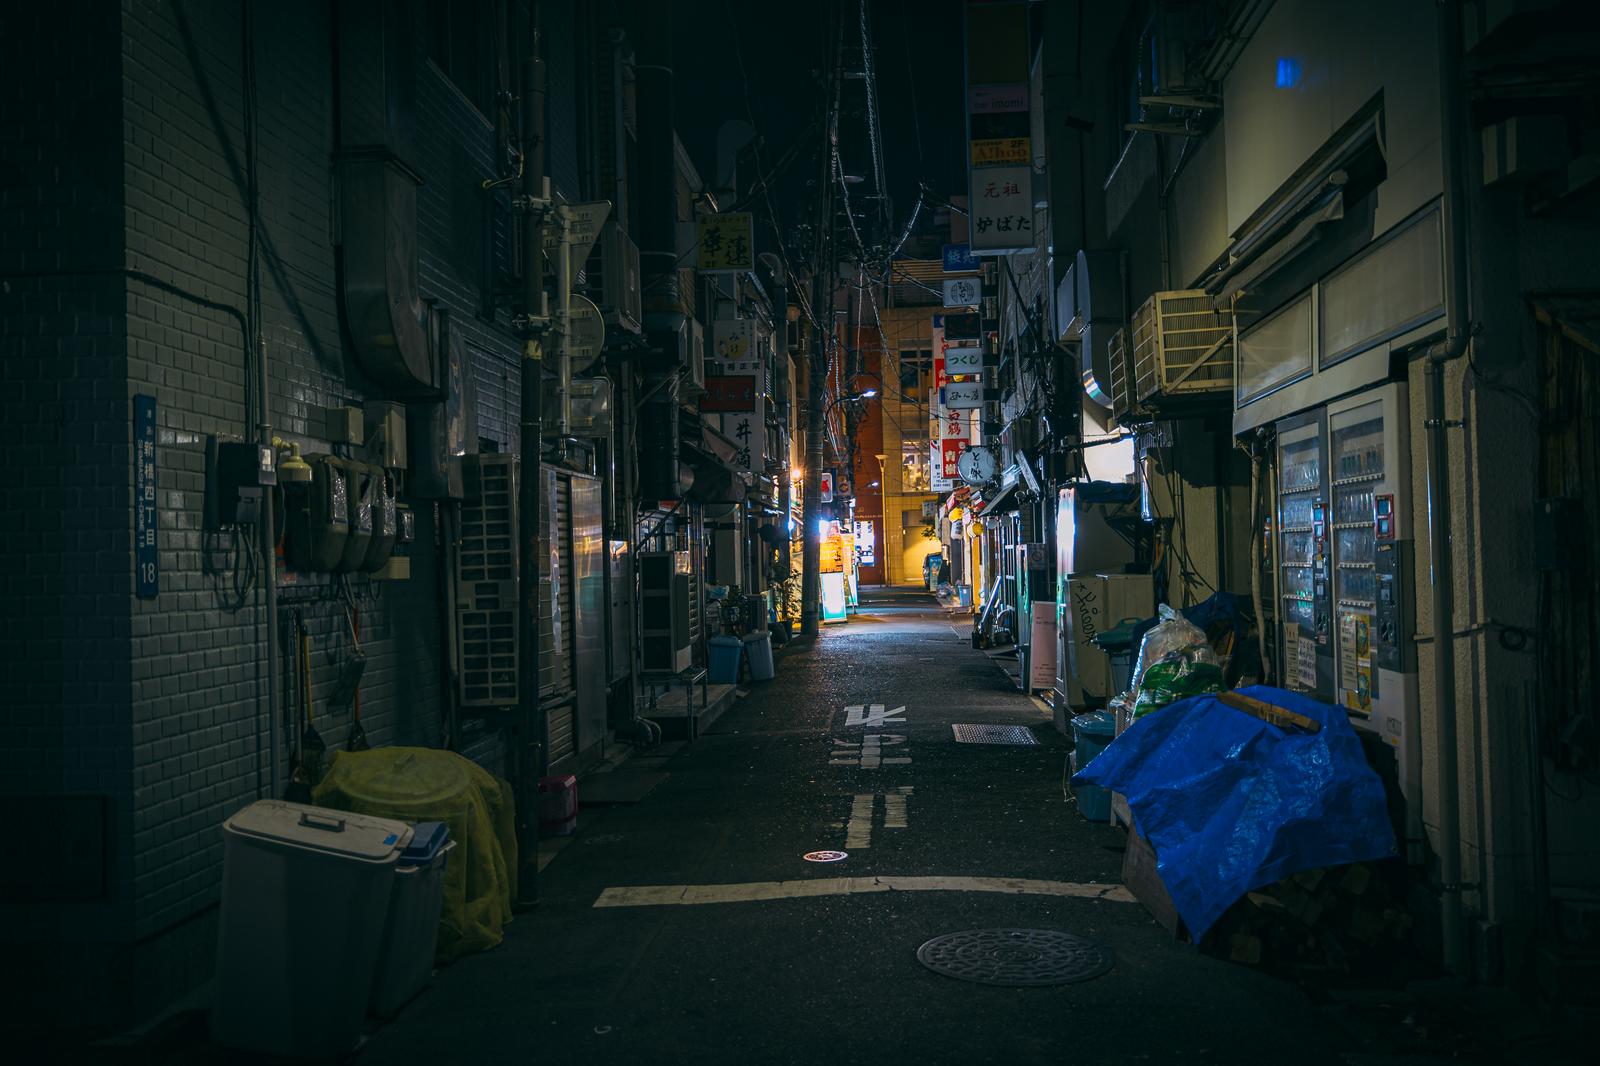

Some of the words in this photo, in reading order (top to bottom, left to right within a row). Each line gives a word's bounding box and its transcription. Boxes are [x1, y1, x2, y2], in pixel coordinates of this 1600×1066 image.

[984, 182, 1021, 199] 元祖
[976, 216, 1031, 233] 炉ばた
[949, 355, 980, 365] つくし
[736, 418, 752, 470] 井筒
[141, 562, 155, 584] 18
